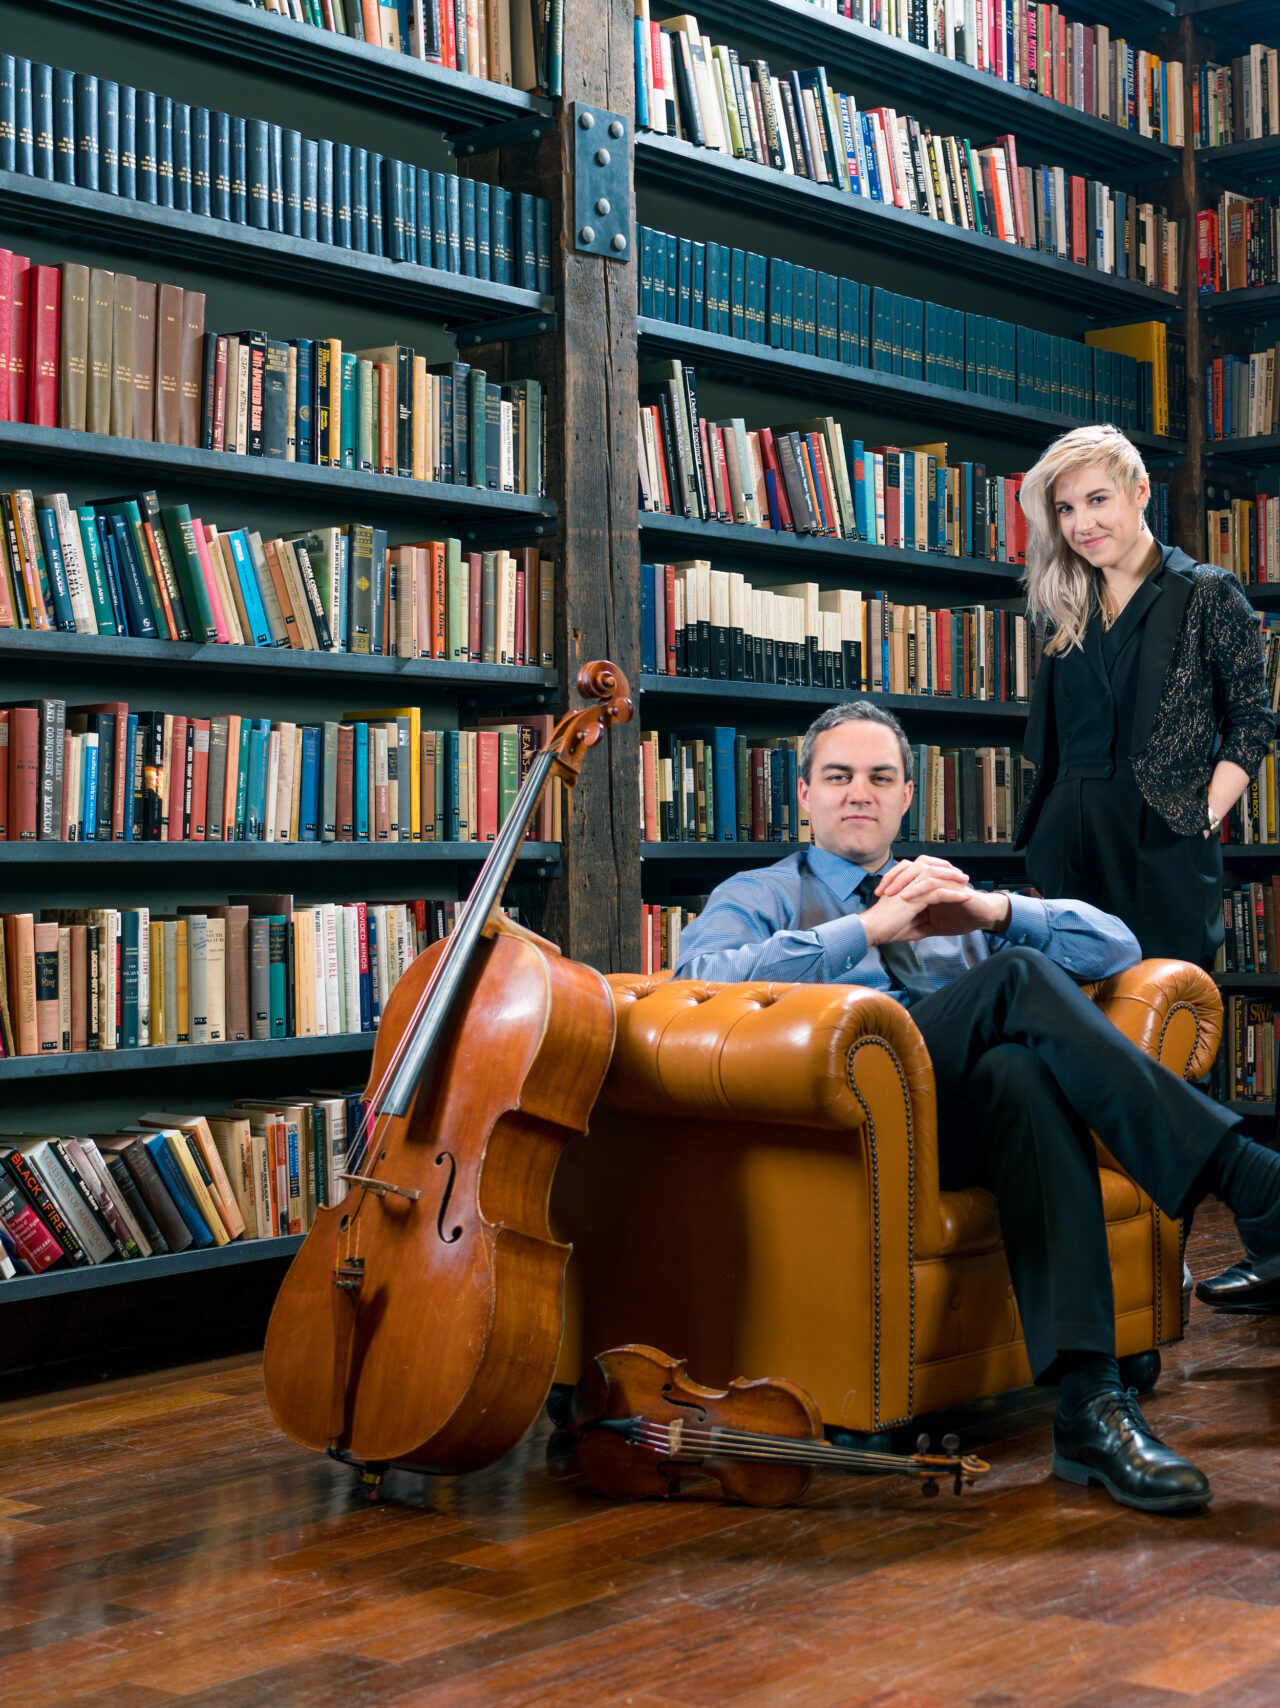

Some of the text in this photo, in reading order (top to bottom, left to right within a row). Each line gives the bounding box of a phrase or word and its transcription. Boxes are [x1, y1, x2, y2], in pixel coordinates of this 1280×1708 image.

[760, 72, 770, 93] HARD
[1127, 48, 1135, 96] EYEWITNESS
[732, 68, 743, 94] BURNING
[738, 95, 746, 114] DOWN
[743, 127, 752, 148] HOUSE
[763, 94, 773, 113] ROAD
[767, 124, 779, 151] GLORY
[840, 97, 855, 153] EYEWITNESS
[914, 150, 922, 166] SHADES
[918, 173, 926, 192] FREEDOM
[251, 350, 265, 432] ANTI-APARTHEID READER
[690, 397, 699, 426] Delicate
[693, 427, 703, 465] Experiment
[8, 520, 15, 530] WE
[87, 526, 96, 542] Black
[12, 545, 19, 553] BE
[13, 554, 21, 571] HEARD
[90, 543, 98, 560] Power
[233, 539, 244, 561] AFRICA
[52, 549, 65, 596] MY RHODESIA
[62, 543, 79, 598] FASHODA
[94, 569, 103, 586] South
[298, 548, 324, 617] AFRICAN CONGRESS
[97, 587, 106, 604] Africa
[436, 554, 445, 638] Precolonial Africa
[55, 705, 64, 781] THE DISCOVERY
[43, 702, 55, 833] AND CONQUEST OF MEXICO
[358, 907, 366, 941] DIVIDED
[36, 957, 58, 965] Closing
[326, 914, 337, 979] FOREVER FREE
[41, 978, 55, 988] Ring
[62, 956, 70, 978] DOVE
[90, 950, 98, 993] LOCKED-OUT
[21, 955, 34, 1023] REEFER MADNESS
[10, 1153, 67, 1233] BLACK FIRE
[47, 1158, 74, 1190] QUESTION
[78, 1208, 109, 1254] MANHOOD
